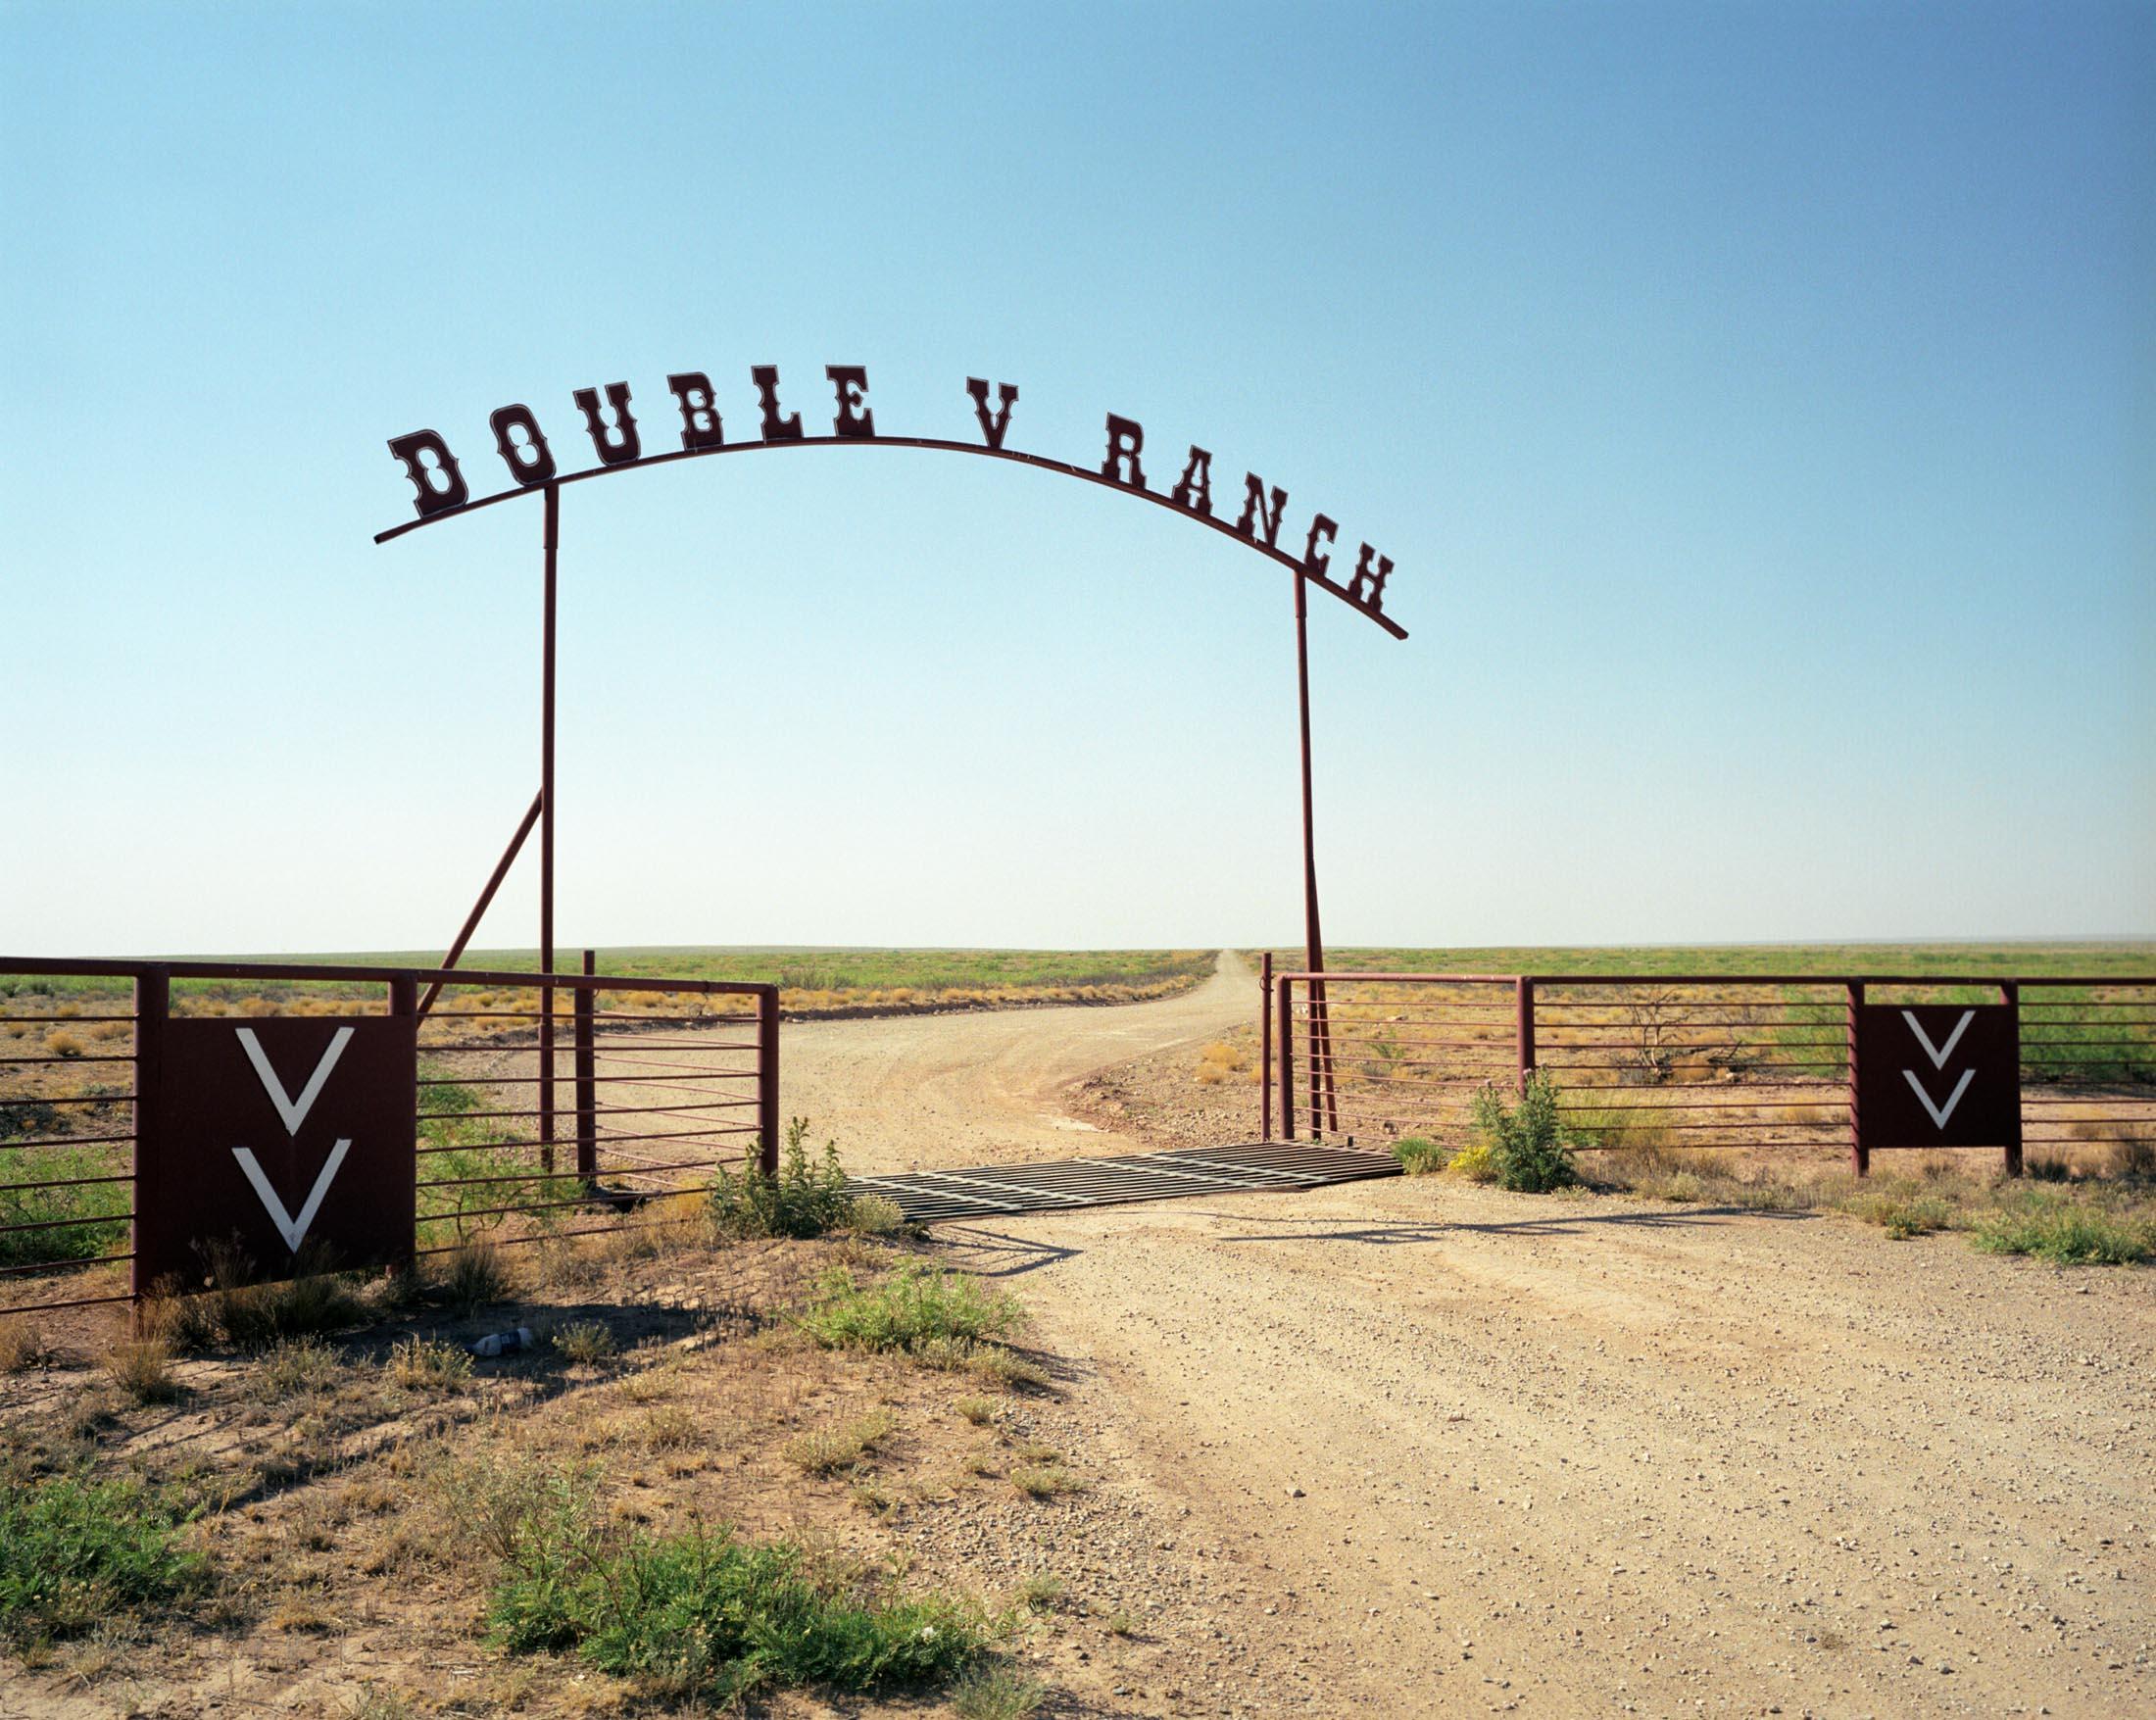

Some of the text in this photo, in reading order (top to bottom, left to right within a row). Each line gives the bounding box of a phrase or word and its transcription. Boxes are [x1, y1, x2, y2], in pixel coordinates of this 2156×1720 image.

[386, 364, 1396, 613] DOUBLE V RANCH
